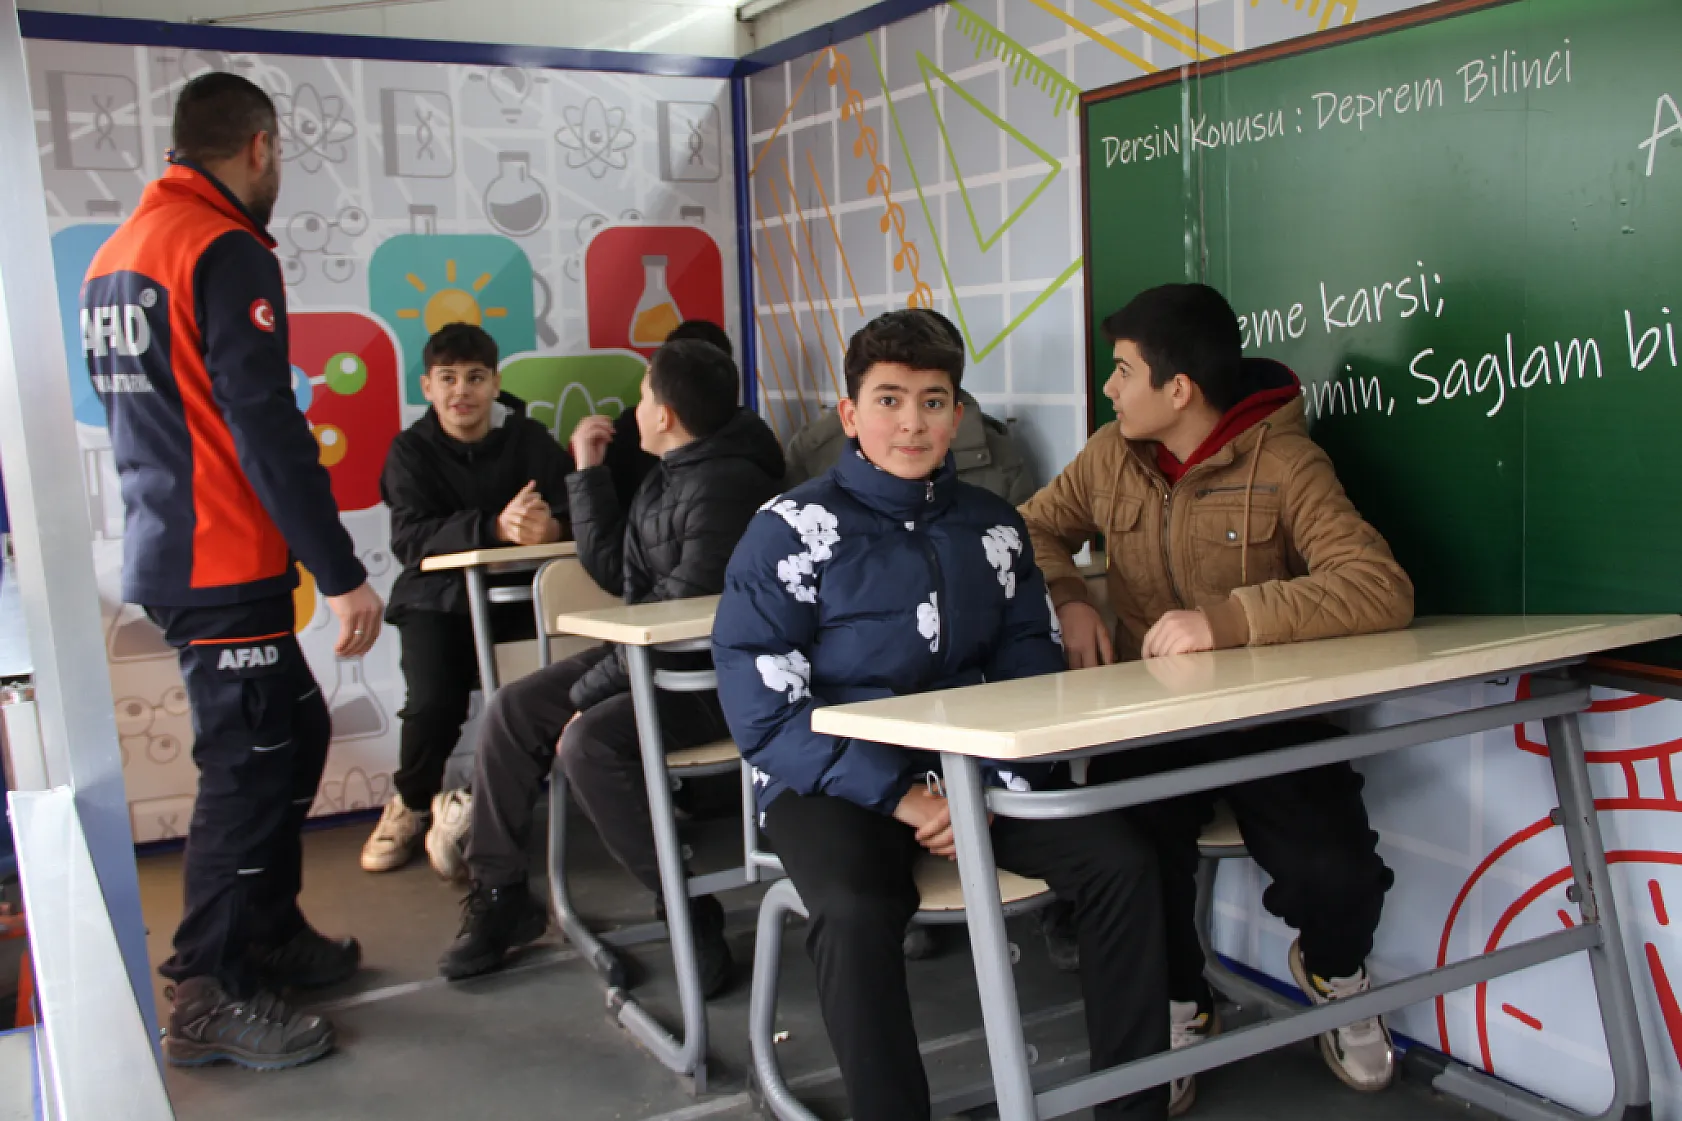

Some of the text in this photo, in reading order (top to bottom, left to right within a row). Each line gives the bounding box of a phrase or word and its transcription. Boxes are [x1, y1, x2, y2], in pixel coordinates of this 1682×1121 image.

[1311, 78, 1443, 131] Deprem
[1456, 38, 1571, 103] Bilinci
[1319, 260, 1444, 333] karsi;
[1409, 332, 1602, 418] Saglam
[1624, 306, 1677, 371] bi
[217, 645, 279, 670] AFAD
